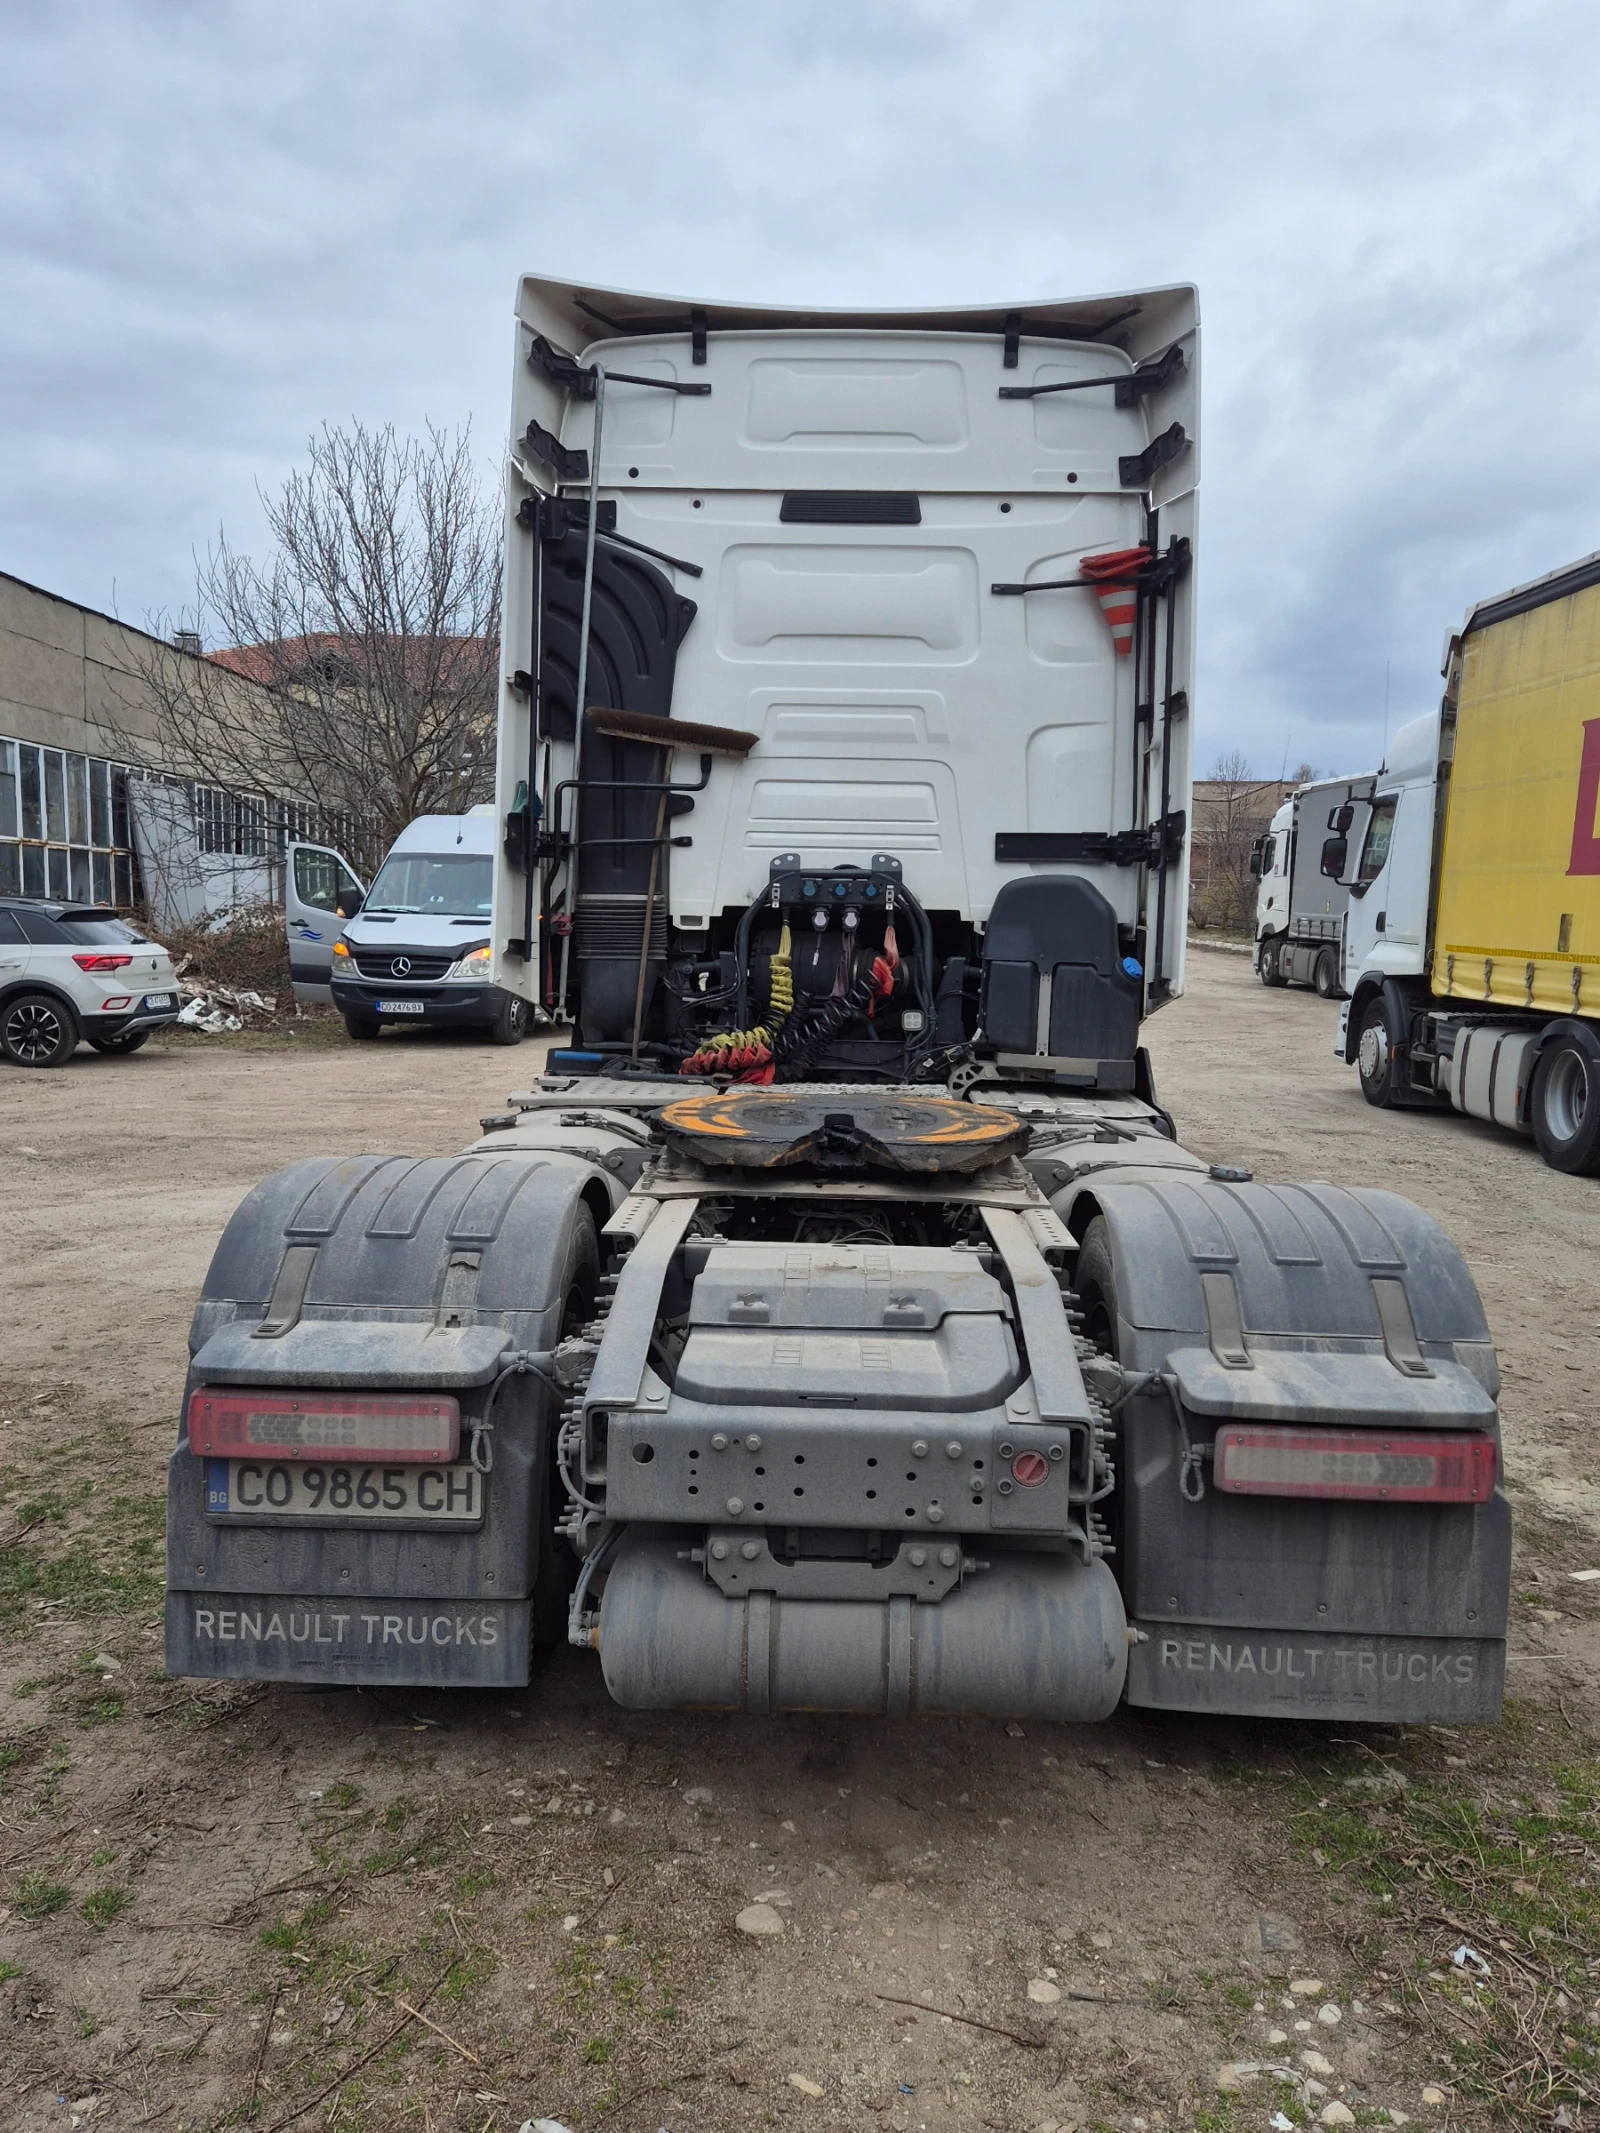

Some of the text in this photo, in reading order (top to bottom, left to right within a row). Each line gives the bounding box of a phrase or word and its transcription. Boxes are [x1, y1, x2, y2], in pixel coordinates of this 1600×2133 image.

[209, 1491, 227, 1503] BG
[237, 1465, 473, 1512] CO 9865 CH
[195, 1610, 499, 1645] RENAULT TRUCKS
[1161, 1640, 1474, 1683] RENAULT TRUCKS
